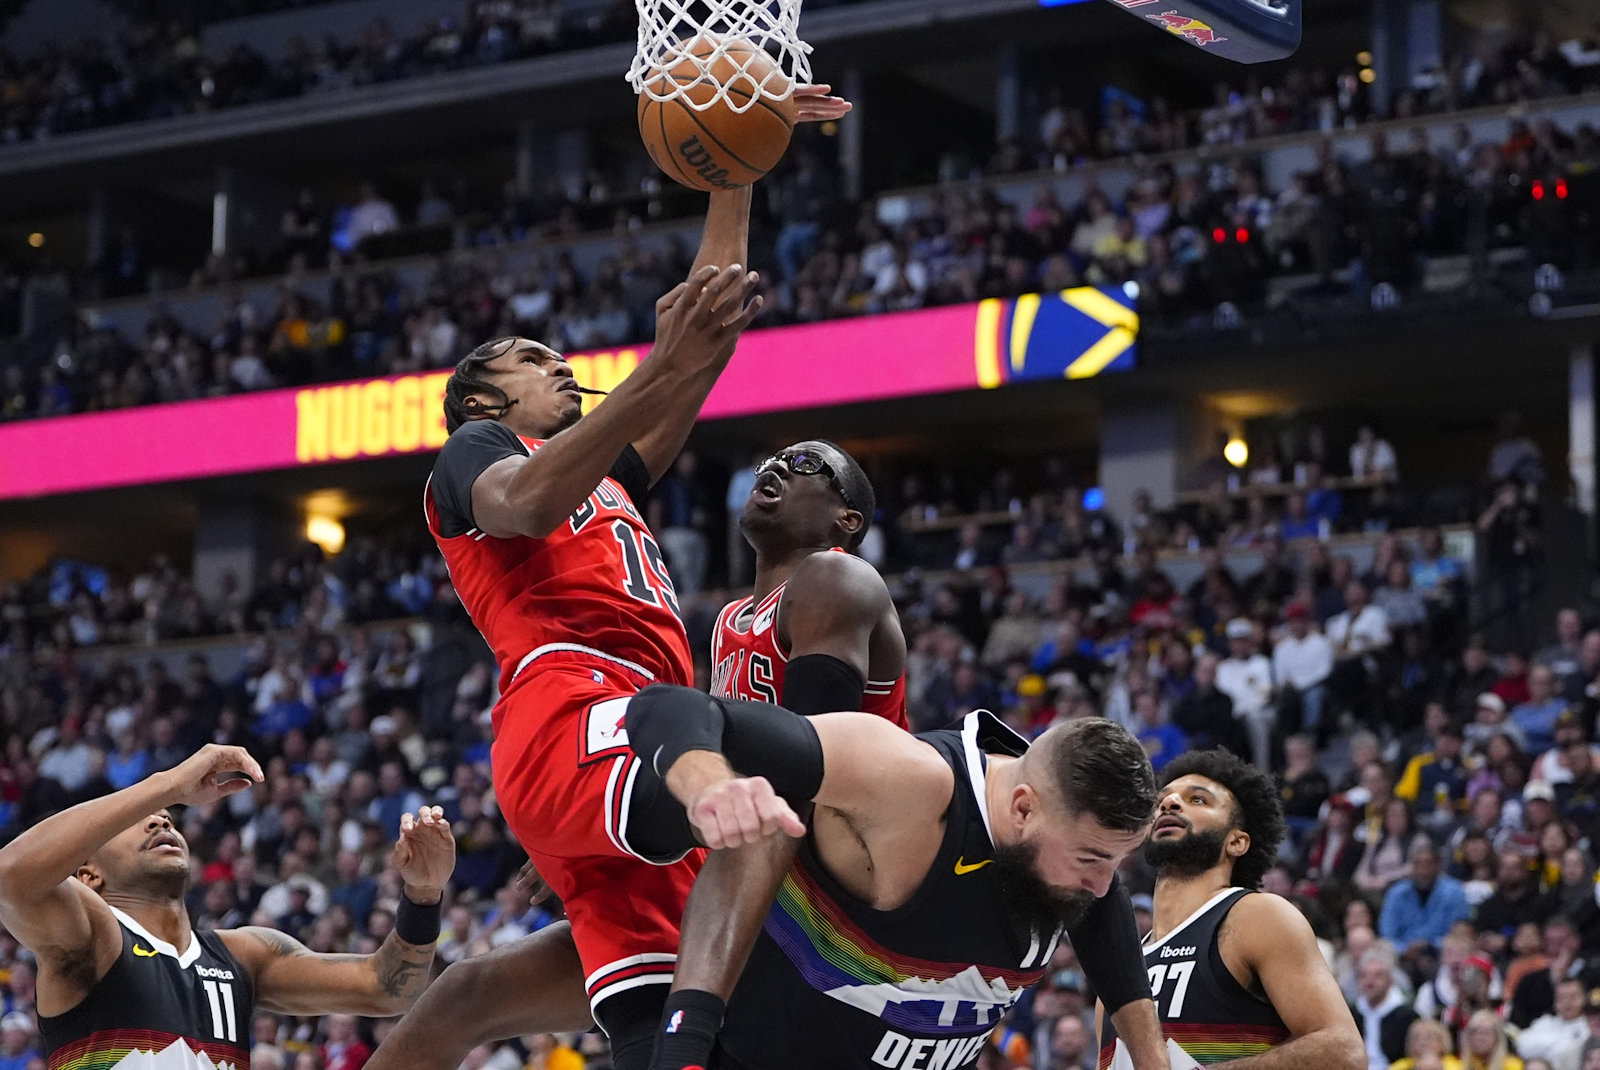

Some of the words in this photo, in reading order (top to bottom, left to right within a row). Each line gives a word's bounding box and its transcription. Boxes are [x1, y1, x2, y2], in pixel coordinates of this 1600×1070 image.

[610, 518, 680, 620] 15
[1160, 946, 1197, 958] ibotta
[195, 964, 234, 980] ibotta
[202, 980, 237, 1042] 11
